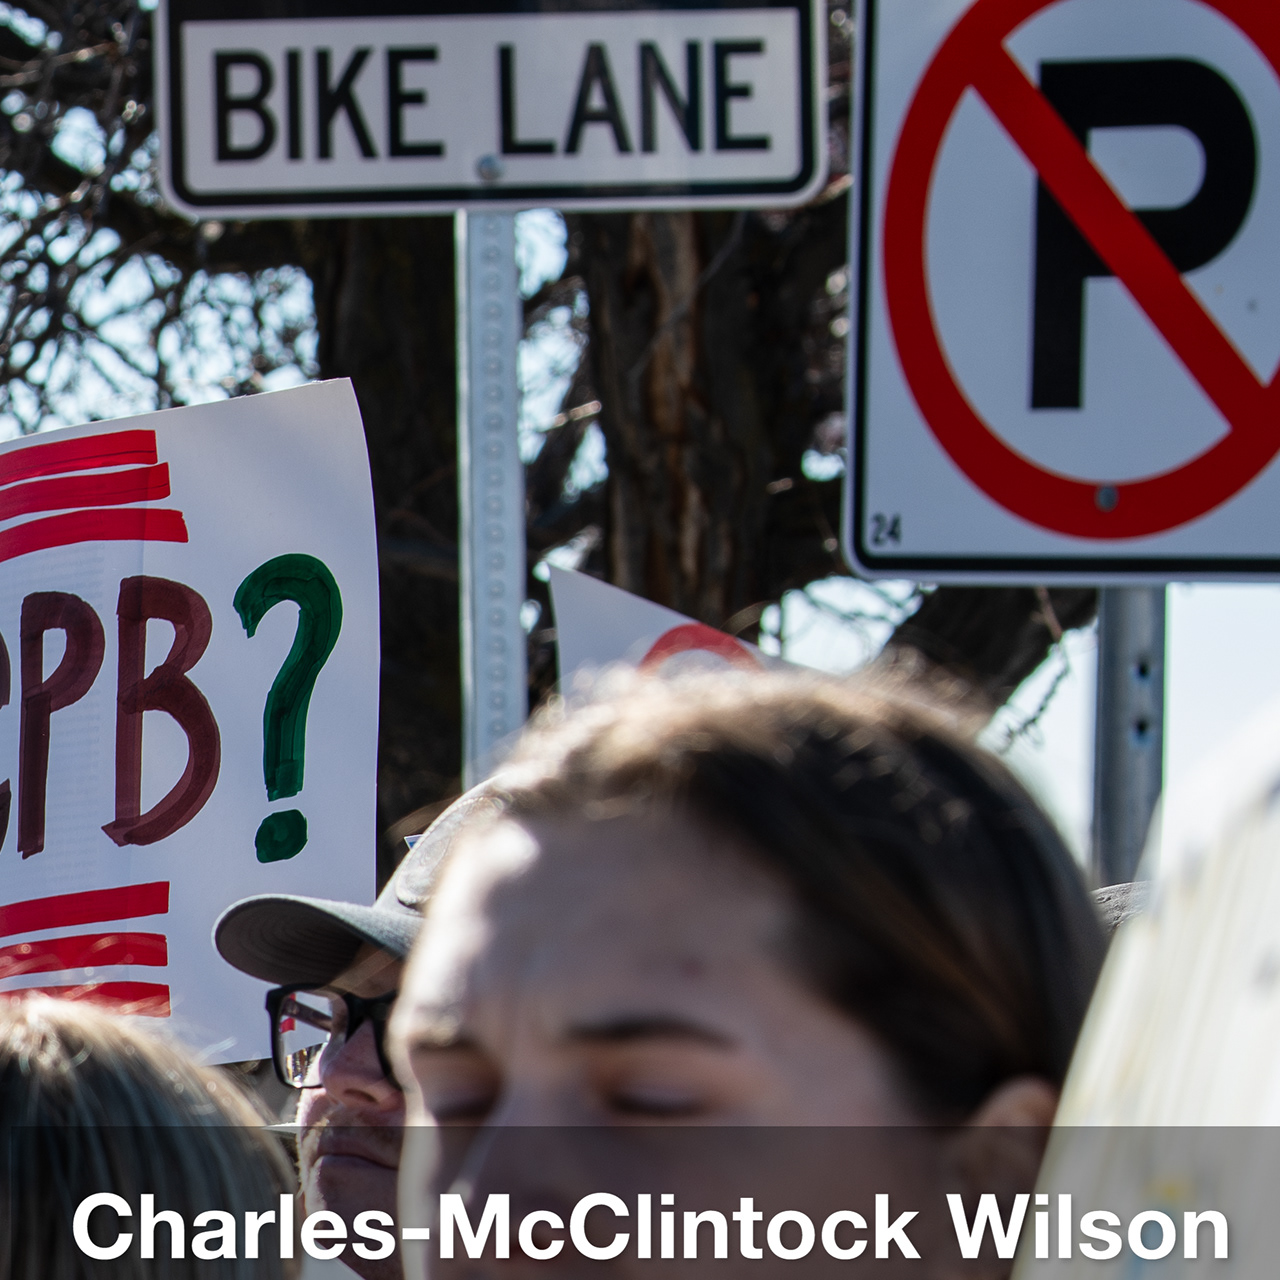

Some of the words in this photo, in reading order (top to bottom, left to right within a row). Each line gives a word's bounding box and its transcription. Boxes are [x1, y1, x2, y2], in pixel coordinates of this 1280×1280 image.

[214, 46, 444, 163] BIKE
[498, 40, 772, 156] LANE
[870, 514, 903, 546] 24
